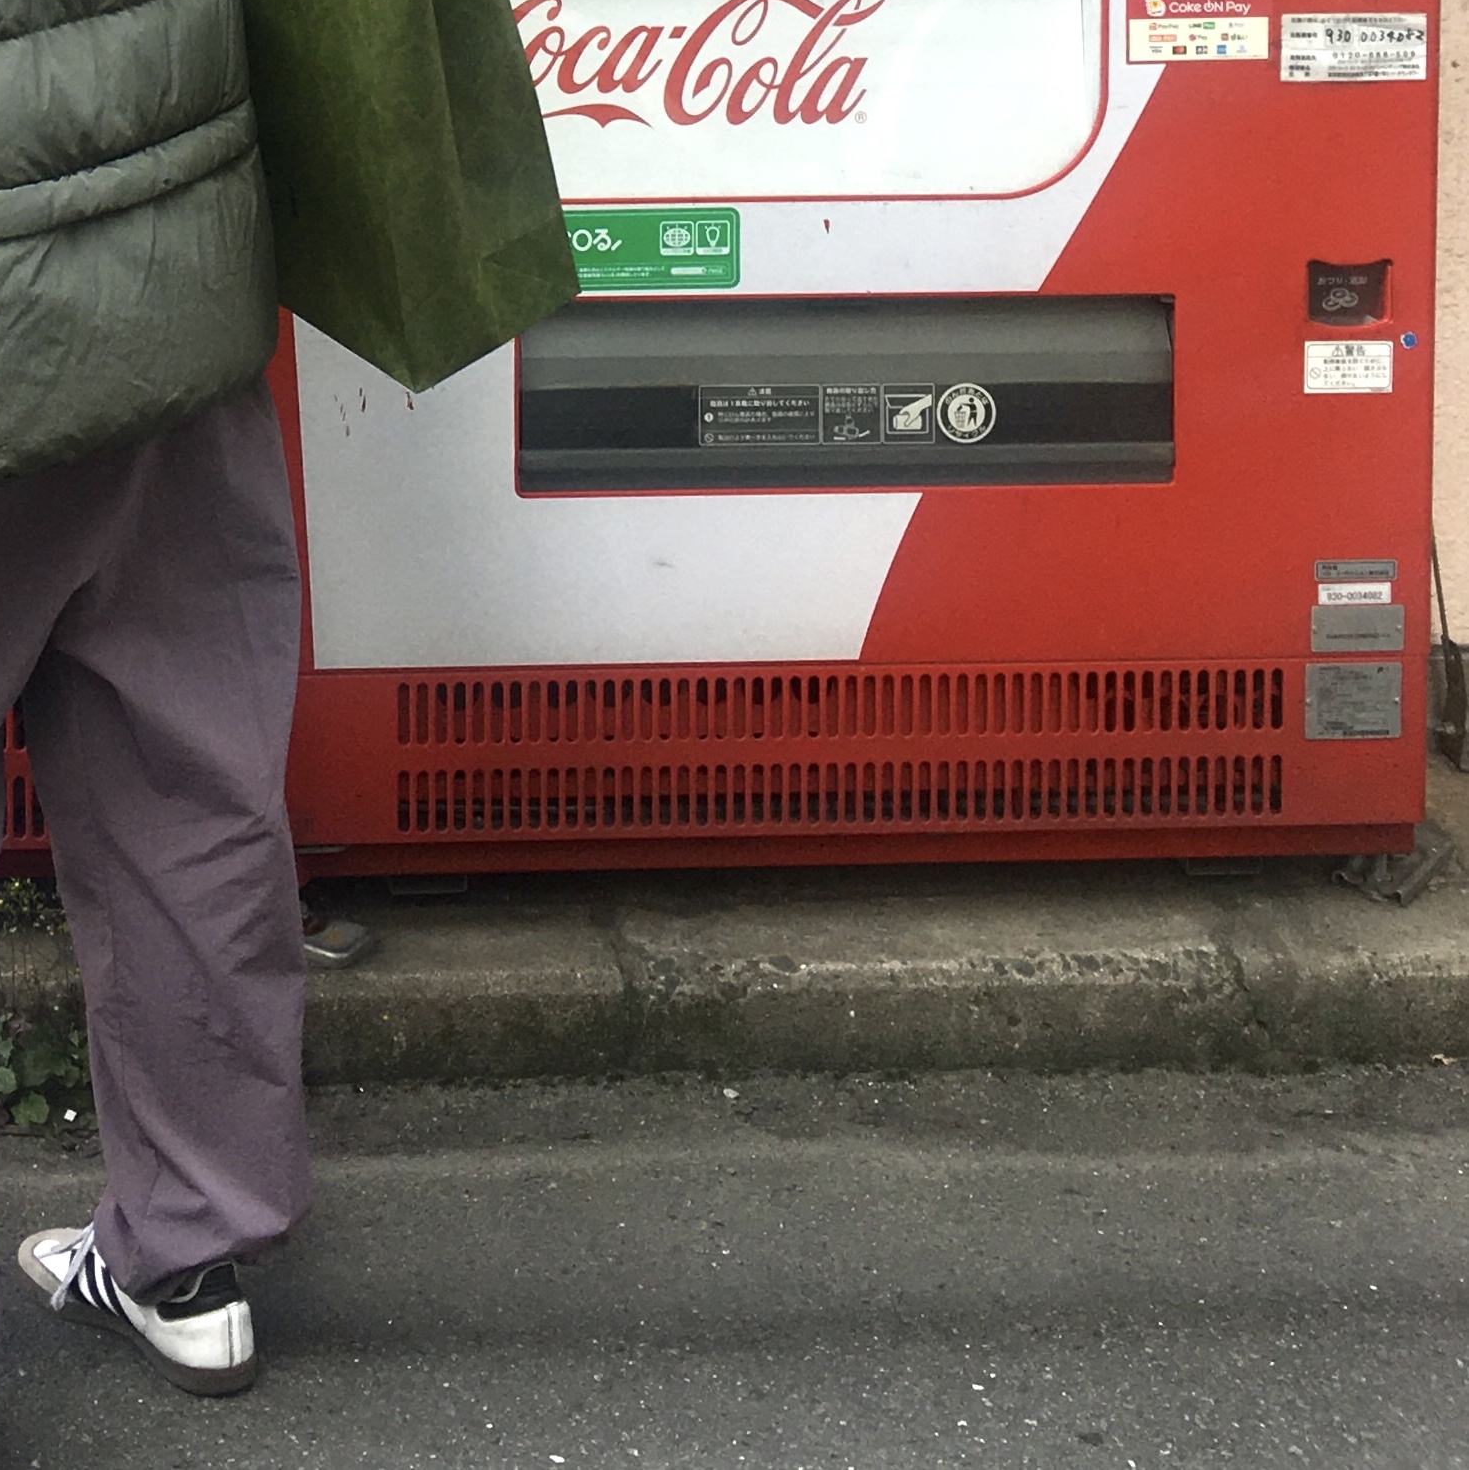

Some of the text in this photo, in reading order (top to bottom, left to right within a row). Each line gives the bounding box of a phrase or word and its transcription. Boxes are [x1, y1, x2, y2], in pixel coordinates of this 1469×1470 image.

[1169, 0, 1251, 15] Coke ON Pay
[1326, 29, 1351, 44] 930
